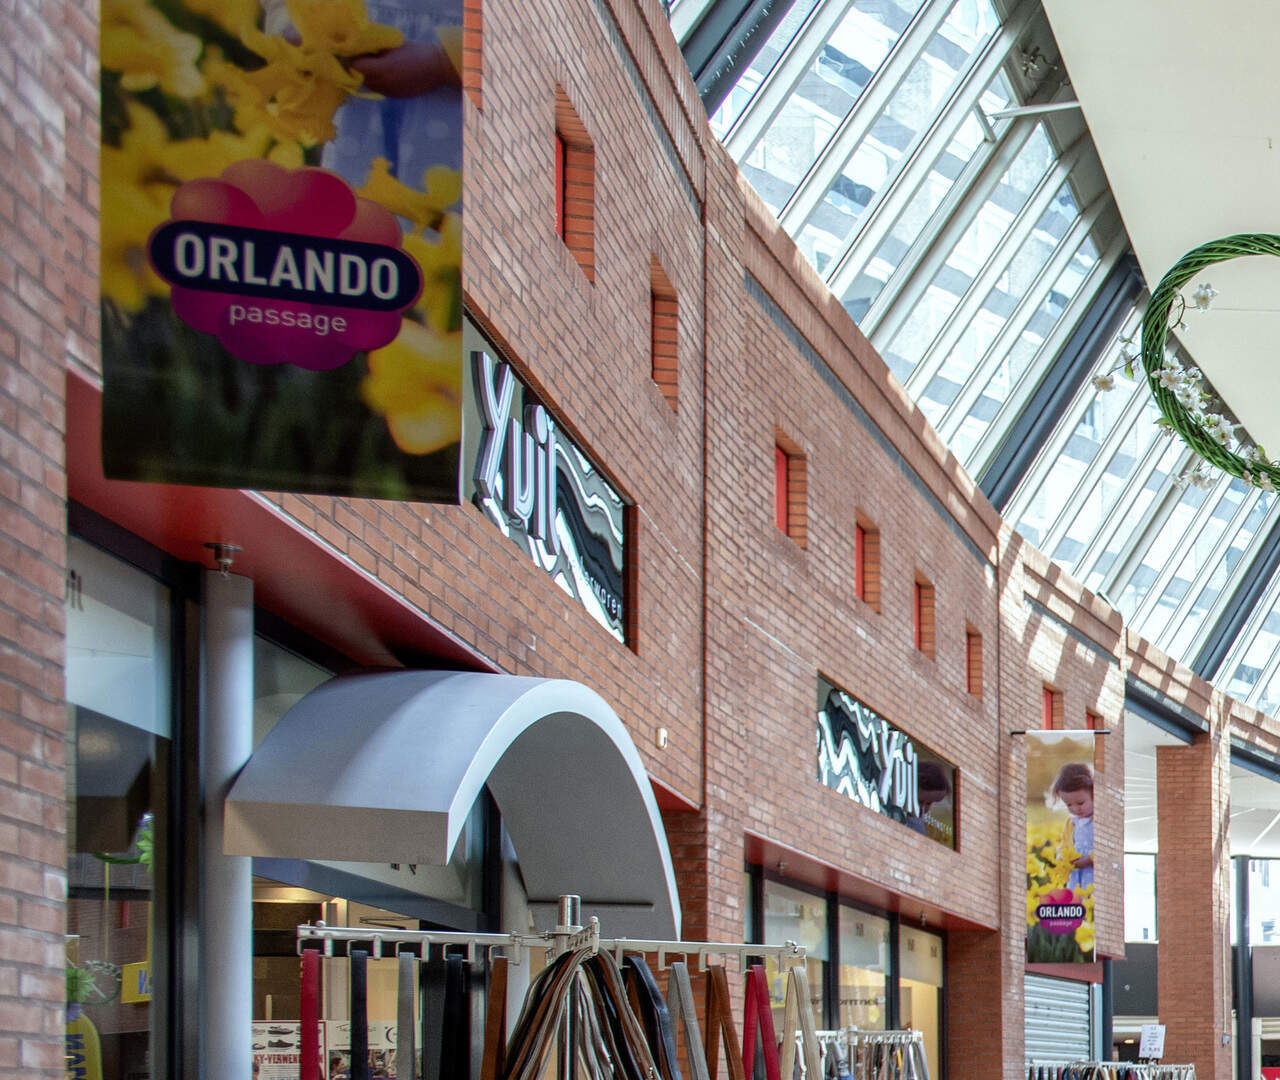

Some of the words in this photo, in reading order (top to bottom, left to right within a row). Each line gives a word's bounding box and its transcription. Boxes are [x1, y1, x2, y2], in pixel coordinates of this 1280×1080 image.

[174, 232, 400, 300] ORLANDO
[229, 303, 347, 335] passage
[1039, 906, 1083, 918] ORLANDO
